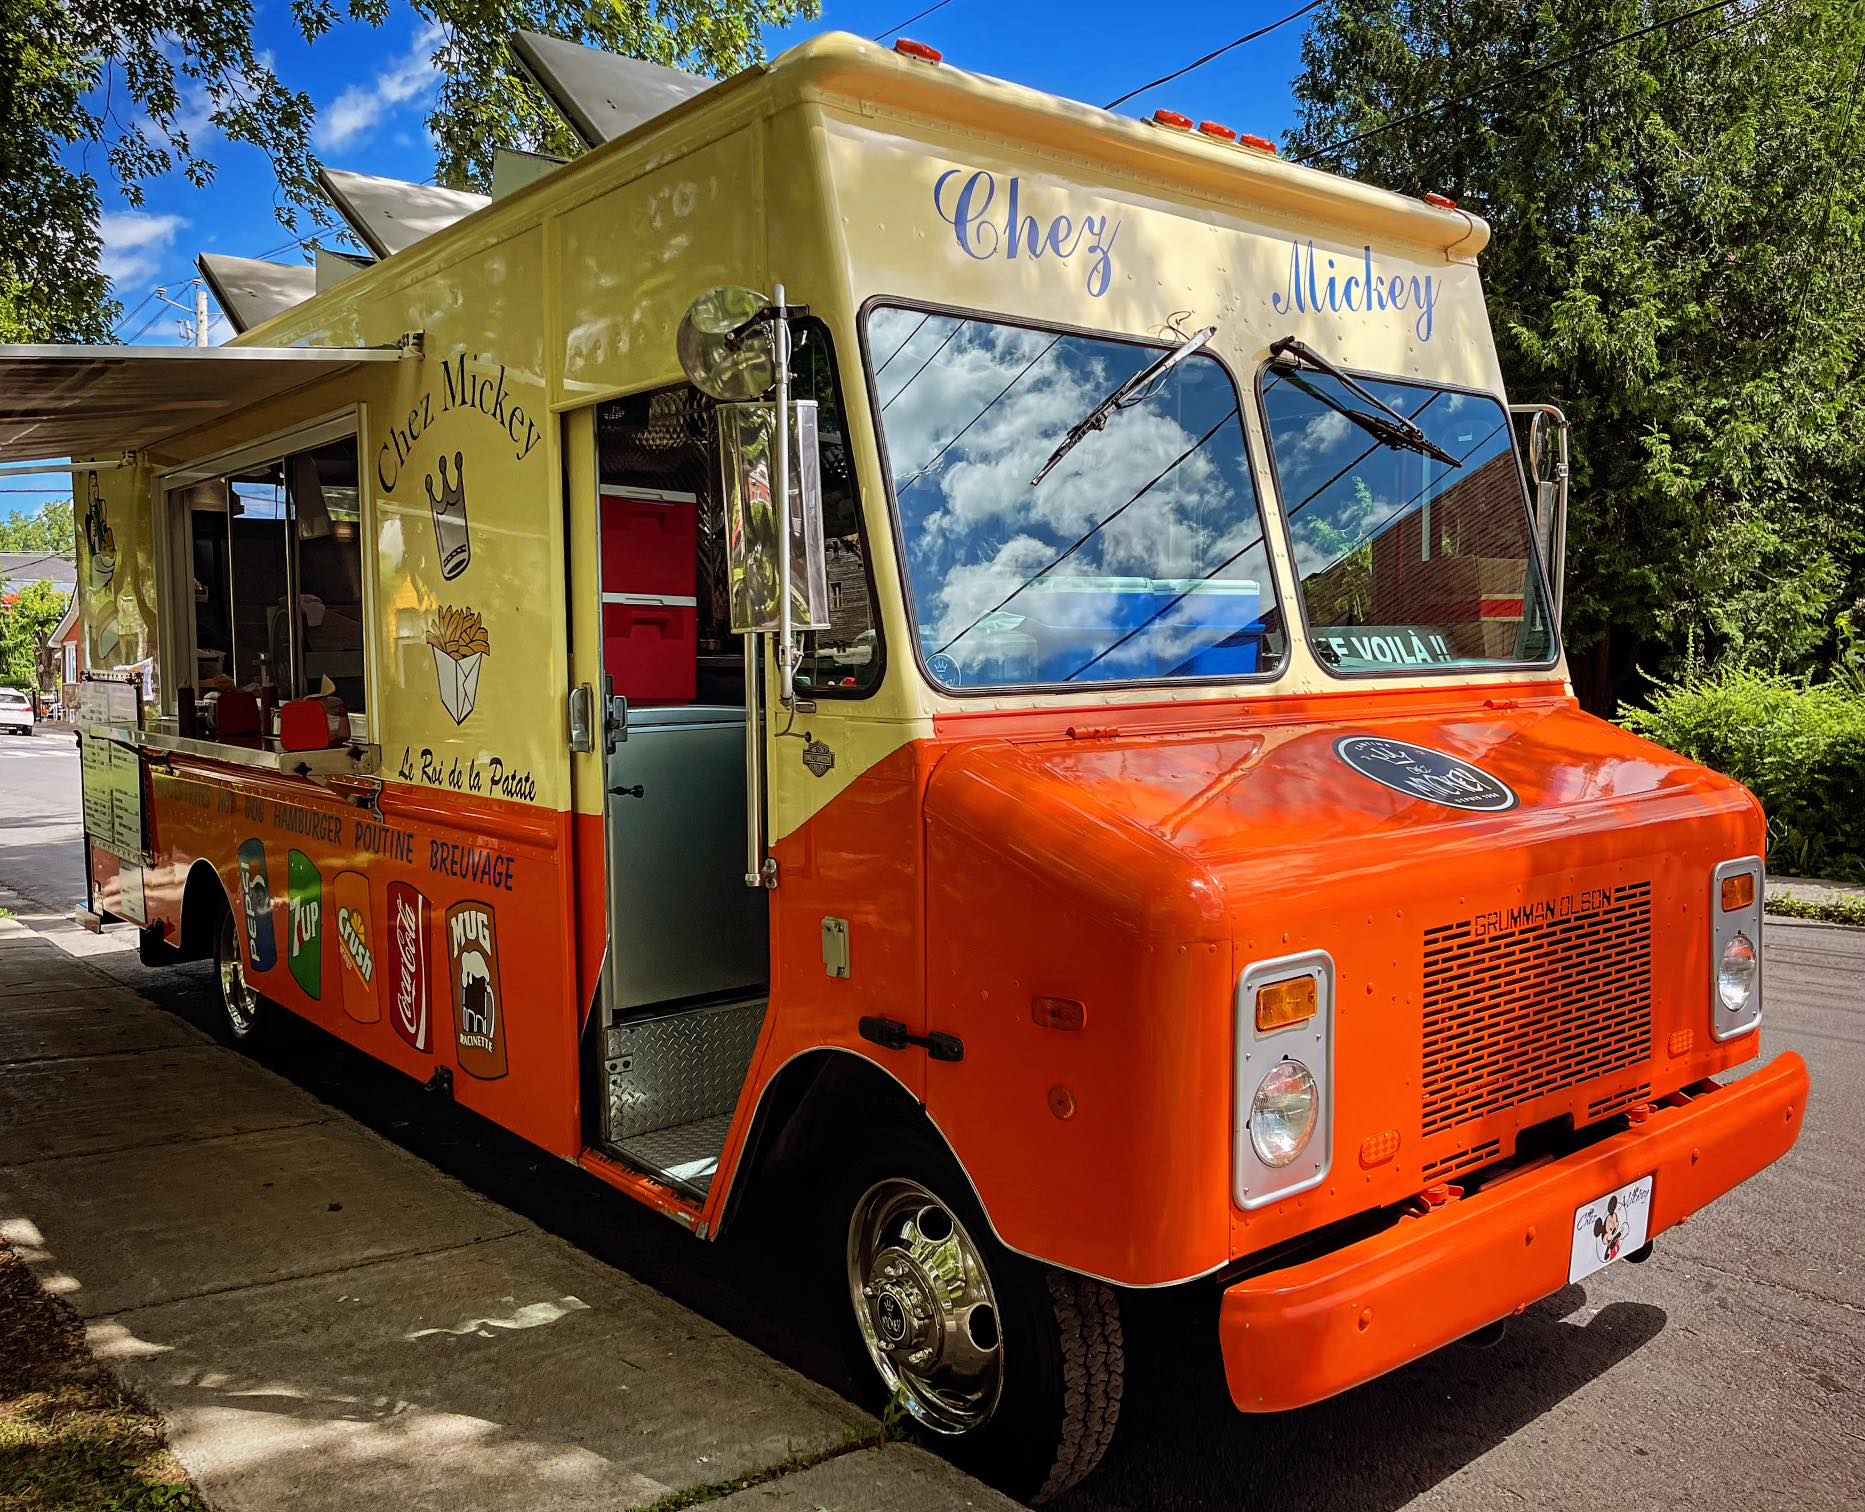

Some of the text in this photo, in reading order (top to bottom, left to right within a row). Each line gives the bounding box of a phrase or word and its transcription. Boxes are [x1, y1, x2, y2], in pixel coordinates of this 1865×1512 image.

[933, 169, 1442, 343] Chez Mickey
[378, 352, 542, 494] Chez Mickey
[1350, 629, 1434, 664] VOILÀ
[398, 746, 537, 802] Le Roi de la Patate
[245, 797, 265, 824] DOG
[273, 800, 343, 847] HAMBURGER
[355, 820, 415, 865] POUTINE
[430, 839, 516, 892] BREUVAGE
[450, 910, 492, 959] MUG
[1475, 887, 1612, 937] GRUMMAN OLSON
[459, 1032, 493, 1054] RACINETTE
